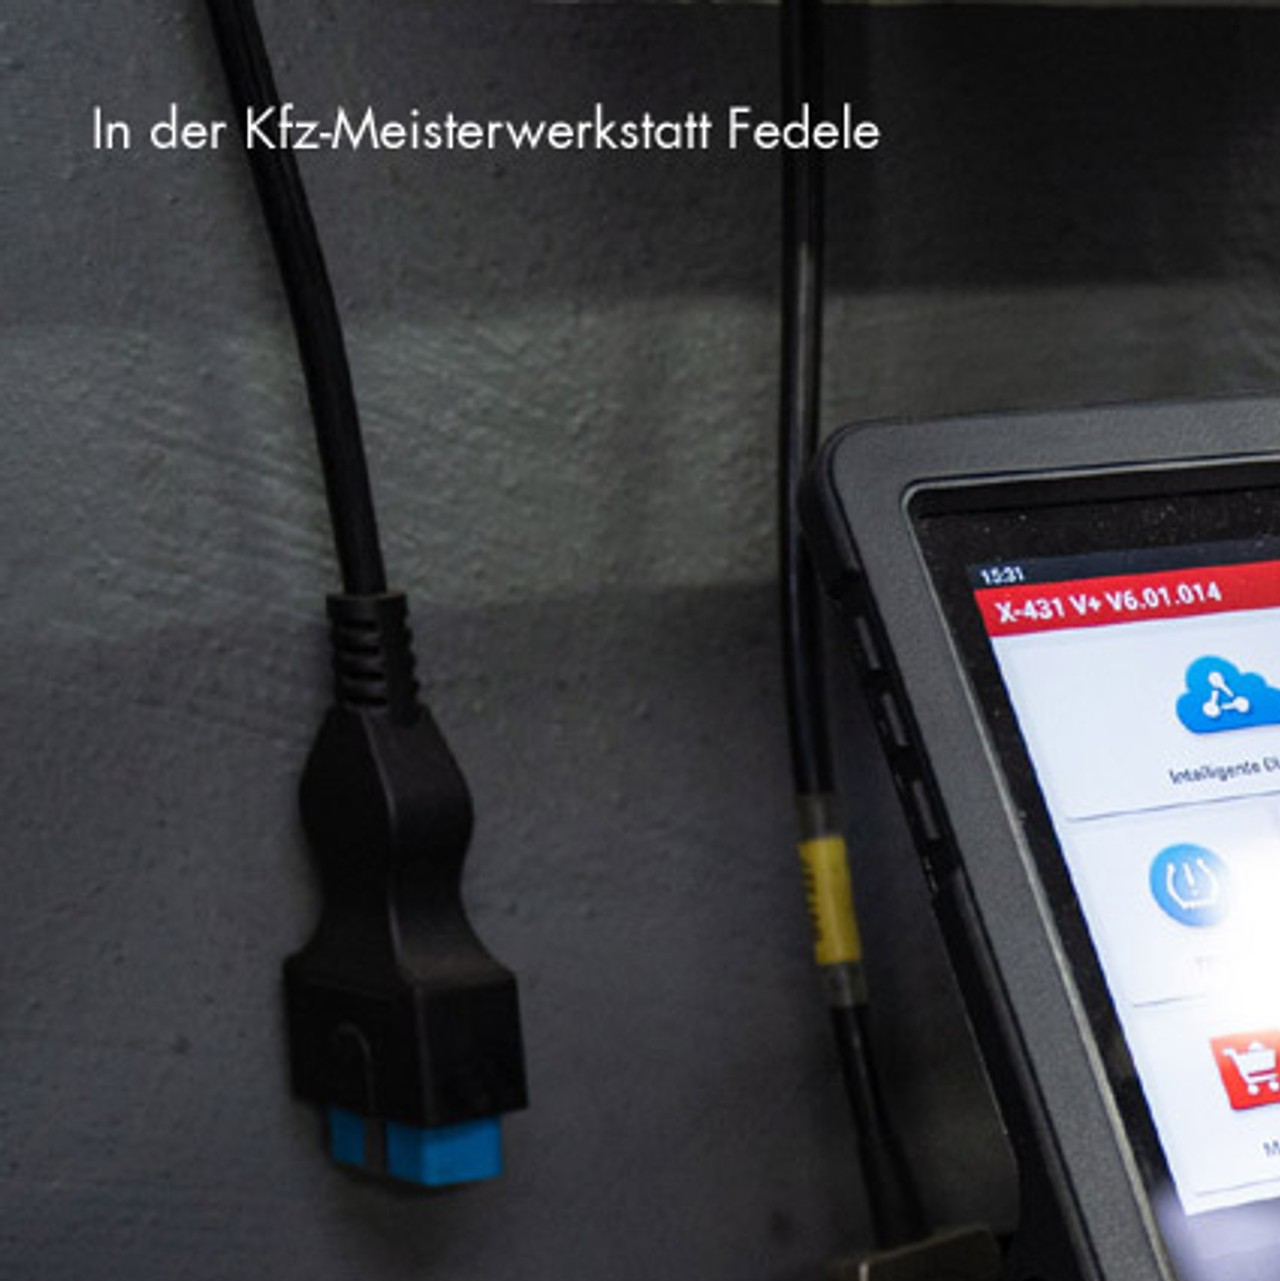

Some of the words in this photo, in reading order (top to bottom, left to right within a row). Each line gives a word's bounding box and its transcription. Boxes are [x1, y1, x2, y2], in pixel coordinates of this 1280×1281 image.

[995, 597, 1065, 623] X-431
[1069, 594, 1101, 616] V+
[1104, 582, 1222, 611] V6.01.014
